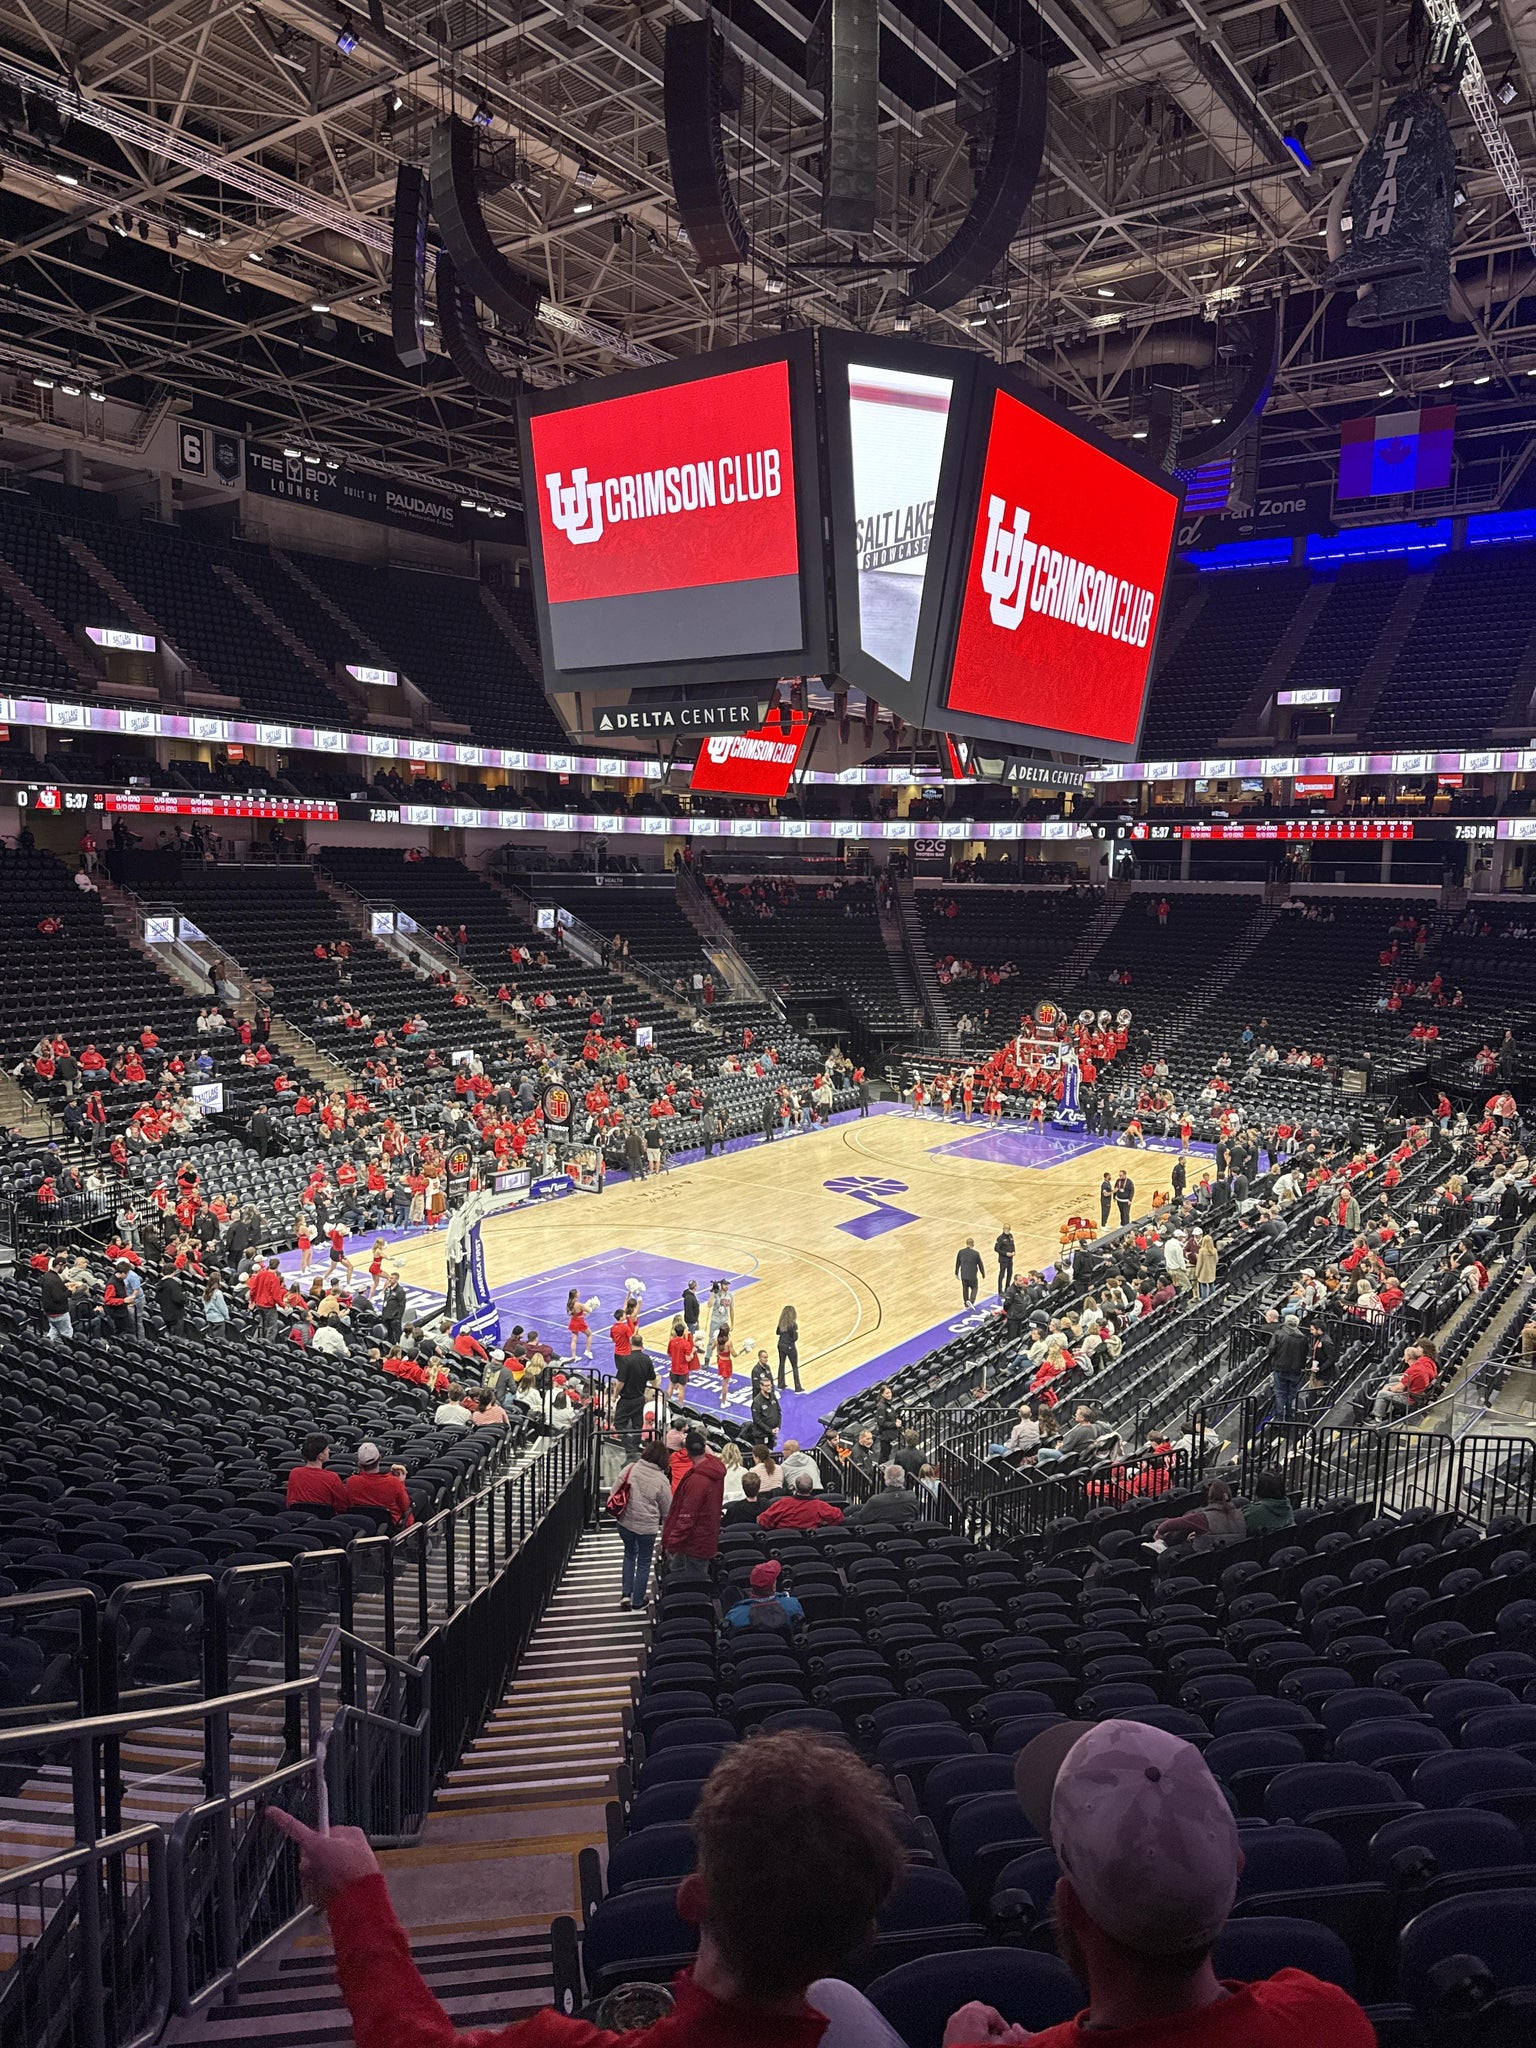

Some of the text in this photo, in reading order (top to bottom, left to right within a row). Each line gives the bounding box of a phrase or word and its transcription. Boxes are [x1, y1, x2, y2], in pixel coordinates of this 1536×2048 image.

[1365, 117, 1414, 239] UTAH
[183, 434, 201, 465] 6
[250, 452, 338, 488] TEE BOX
[271, 478, 319, 502] LOUNGE
[343, 486, 377, 502] BUILT BY
[604, 460, 716, 523] CRIMSON
[718, 448, 782, 505] CLUB
[386, 491, 454, 521] PAUDAVIS
[1259, 499, 1307, 517] Zone
[856, 500, 935, 554] SALT LAKE
[865, 539, 927, 569] SHOWCASE
[1030, 544, 1118, 636] CRIMSON
[1111, 580, 1155, 648] CLUB
[617, 706, 750, 729] DELTA CENTER
[730, 736, 774, 763] CRIMSON
[773, 743, 797, 764] CLUB
[1018, 766, 1084, 787] DELTA CENTER
[17, 791, 28, 806] 0
[65, 793, 88, 808] 5:37
[370, 809, 400, 822] 7:59 PM
[1098, 827, 1106, 838] 0
[1118, 827, 1125, 838] 0
[1151, 827, 1169, 838] 5:37
[1455, 825, 1495, 839] 7:59 PM
[914, 839, 946, 852] G2G
[551, 1101, 568, 1118] 30
[452, 1162, 465, 1174] 30
[474, 1239, 487, 1297] AMERICA FIRST
